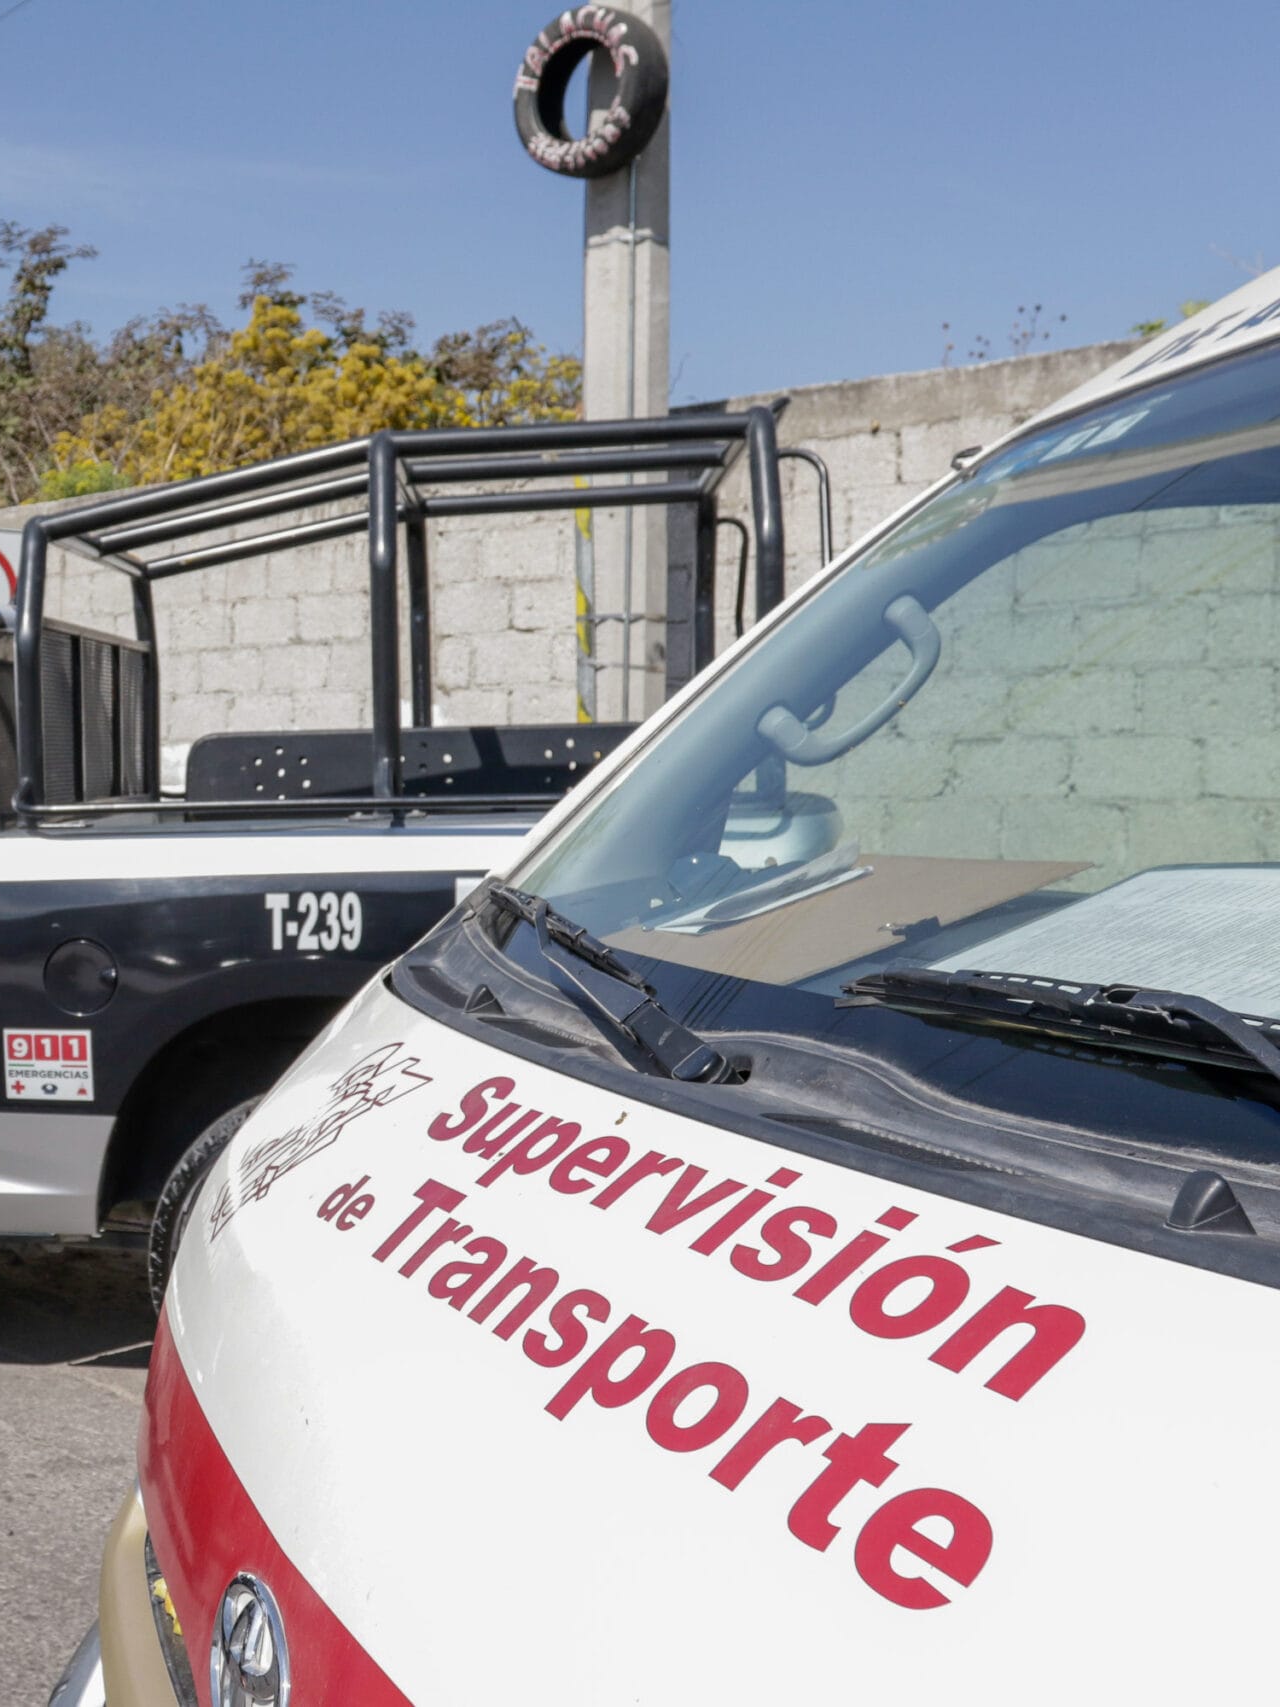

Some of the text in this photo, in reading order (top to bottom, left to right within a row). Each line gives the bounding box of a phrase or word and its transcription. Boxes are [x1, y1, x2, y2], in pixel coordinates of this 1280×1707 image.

[265, 891, 363, 951] T-239
[8, 1069, 89, 1080] EMERGENCIAS
[12, 1037, 80, 1058] 911
[427, 1076, 1086, 1402] Supervisión
[317, 1175, 994, 1610] de Transporte
